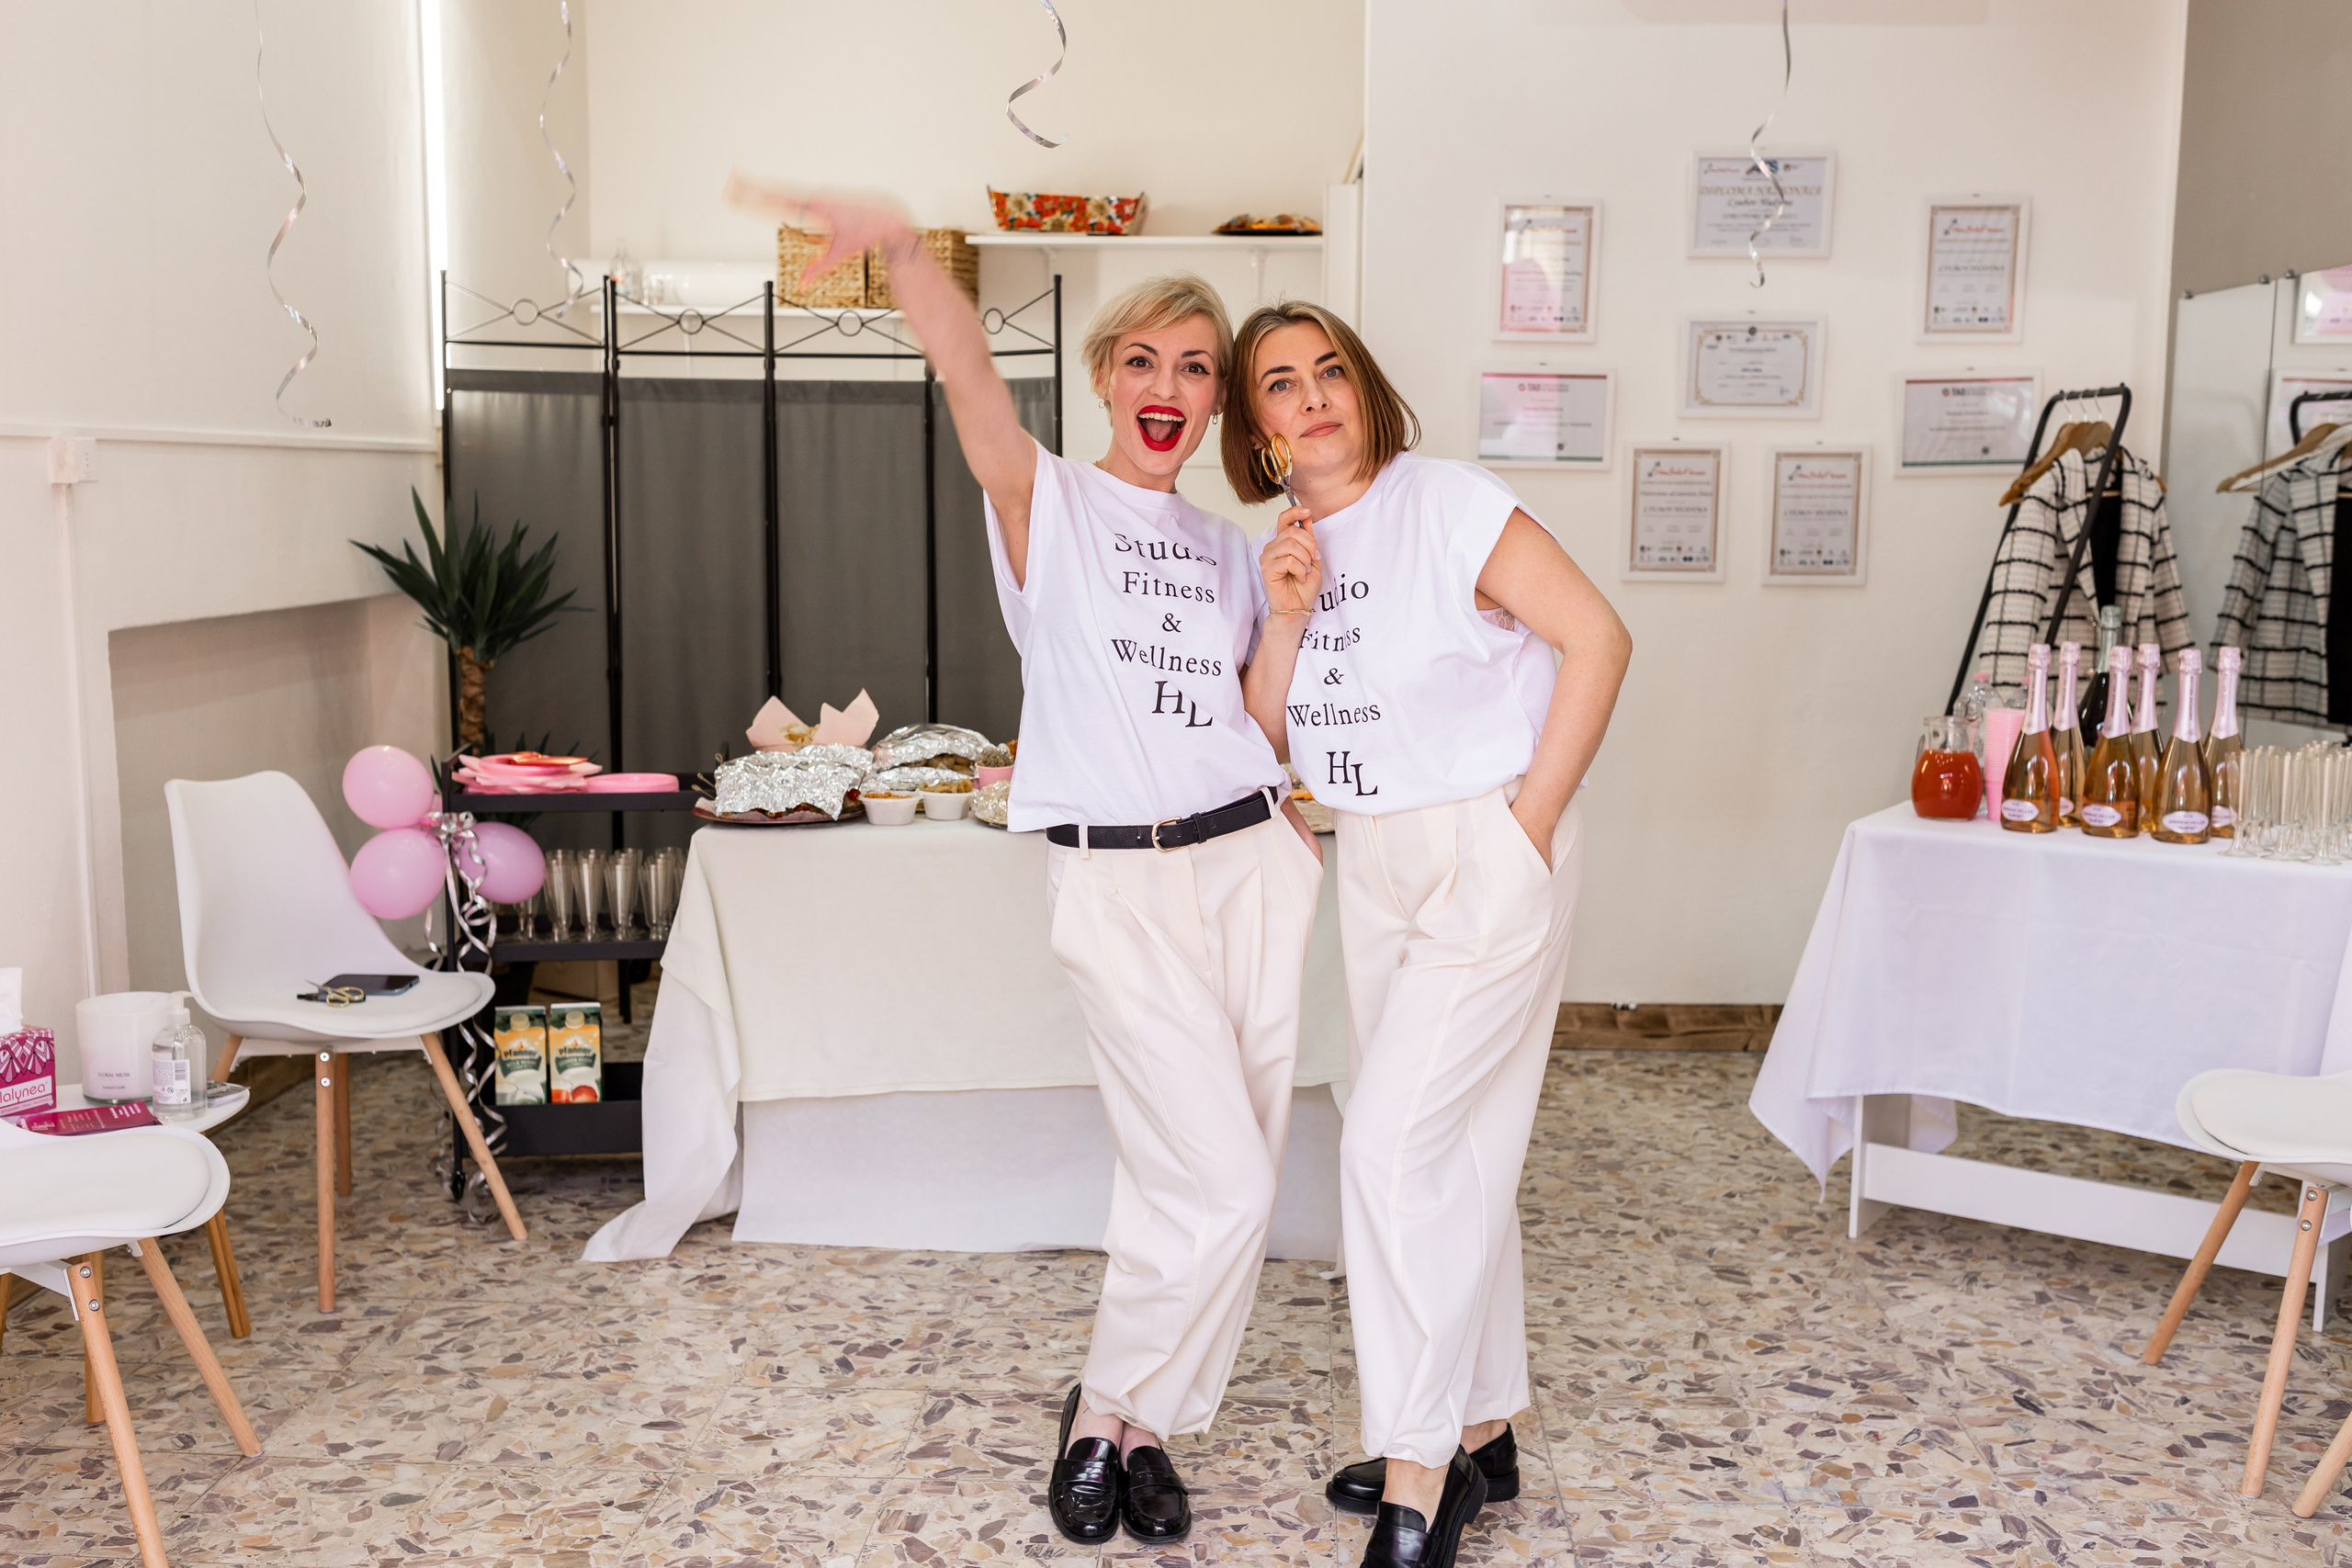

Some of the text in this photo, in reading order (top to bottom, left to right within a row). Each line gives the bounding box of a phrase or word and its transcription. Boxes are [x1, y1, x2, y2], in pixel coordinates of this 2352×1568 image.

[1114, 533, 1217, 567] Studo
[1123, 570, 1216, 604] Fitness
[1314, 573, 1369, 613] udio
[1161, 613, 1182, 633] &
[1299, 627, 1361, 652] Fitnss
[1111, 638, 1222, 677] Wellness
[1323, 668, 1344, 685] &
[1287, 703, 1381, 728] Wellness
